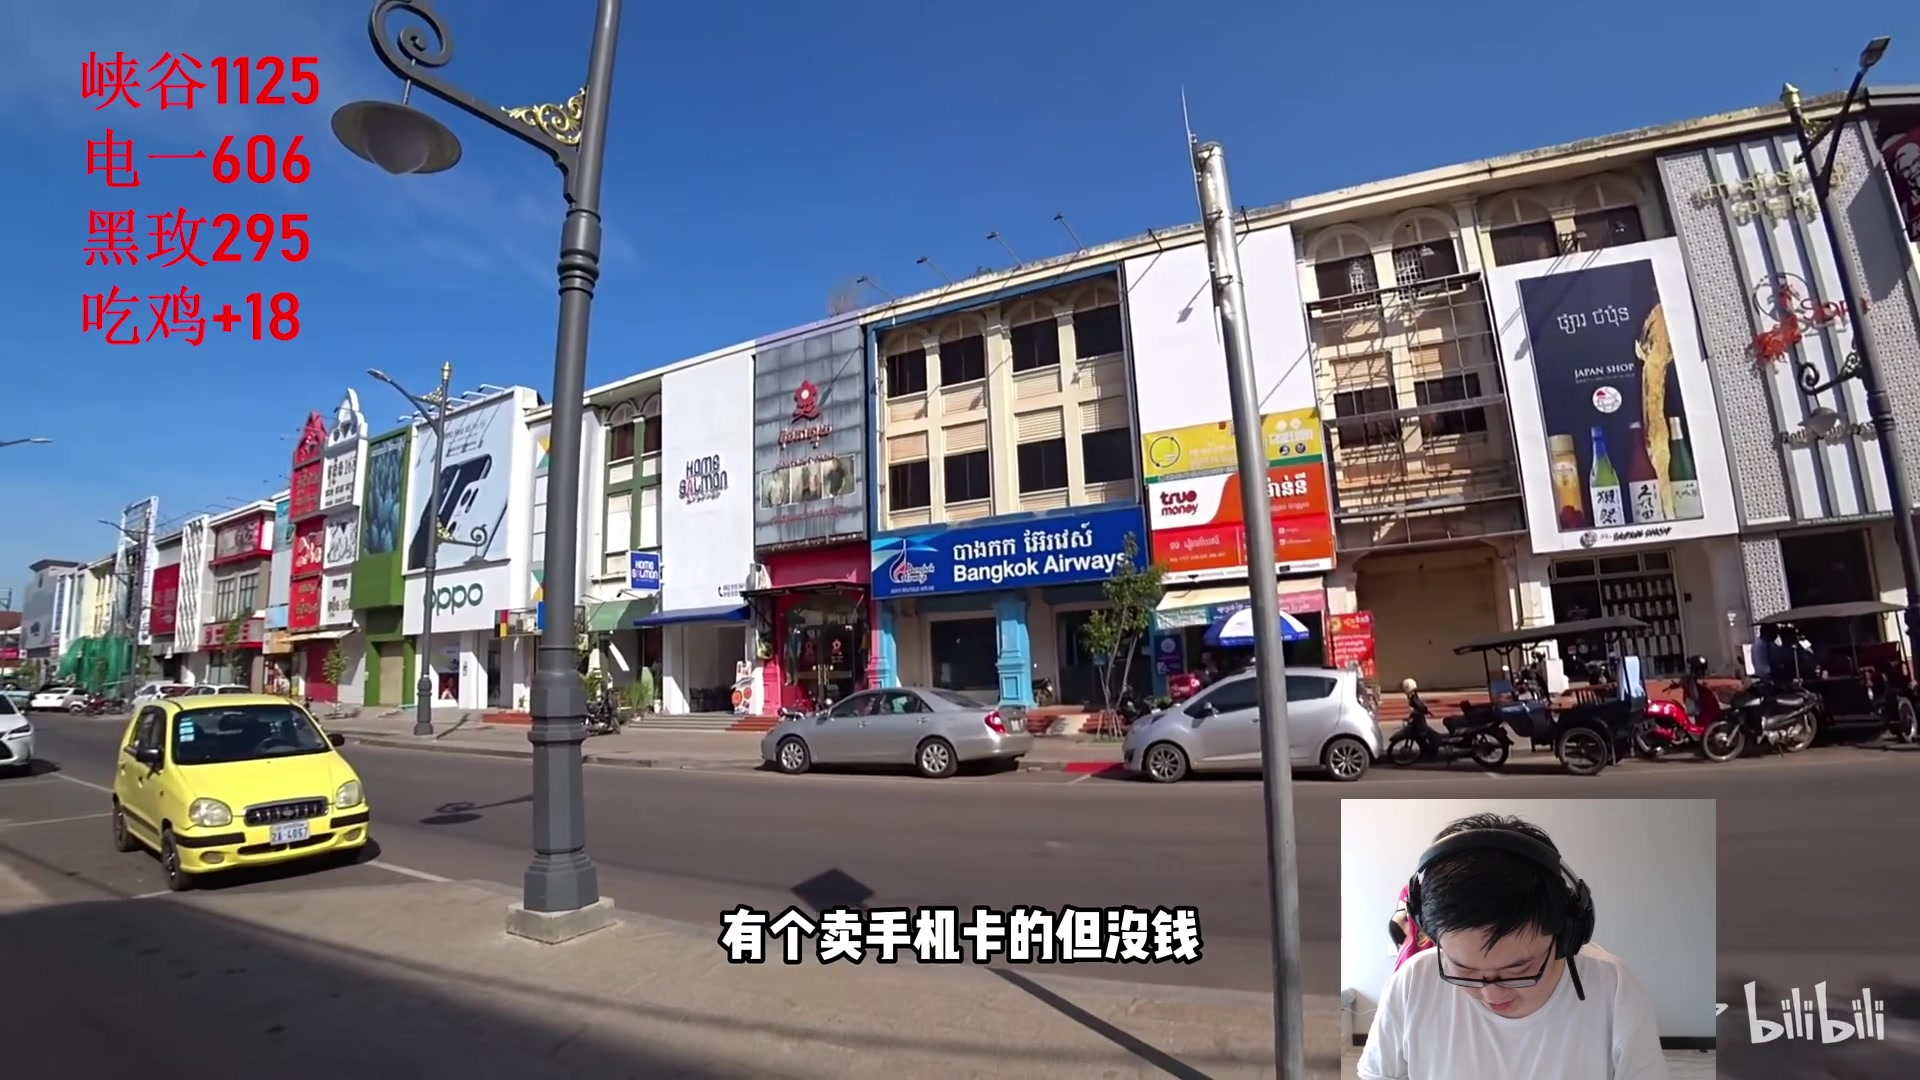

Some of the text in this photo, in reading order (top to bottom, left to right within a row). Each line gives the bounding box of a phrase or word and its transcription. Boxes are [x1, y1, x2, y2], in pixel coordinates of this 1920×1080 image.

[1574, 366, 1604, 379] JAPAN
[1606, 363, 1635, 373] SHOP
[1160, 490, 1197, 505] true
[1161, 503, 1199, 516] money
[953, 539, 1016, 561] បាងកក
[953, 551, 1128, 583] Bangkok Airways
